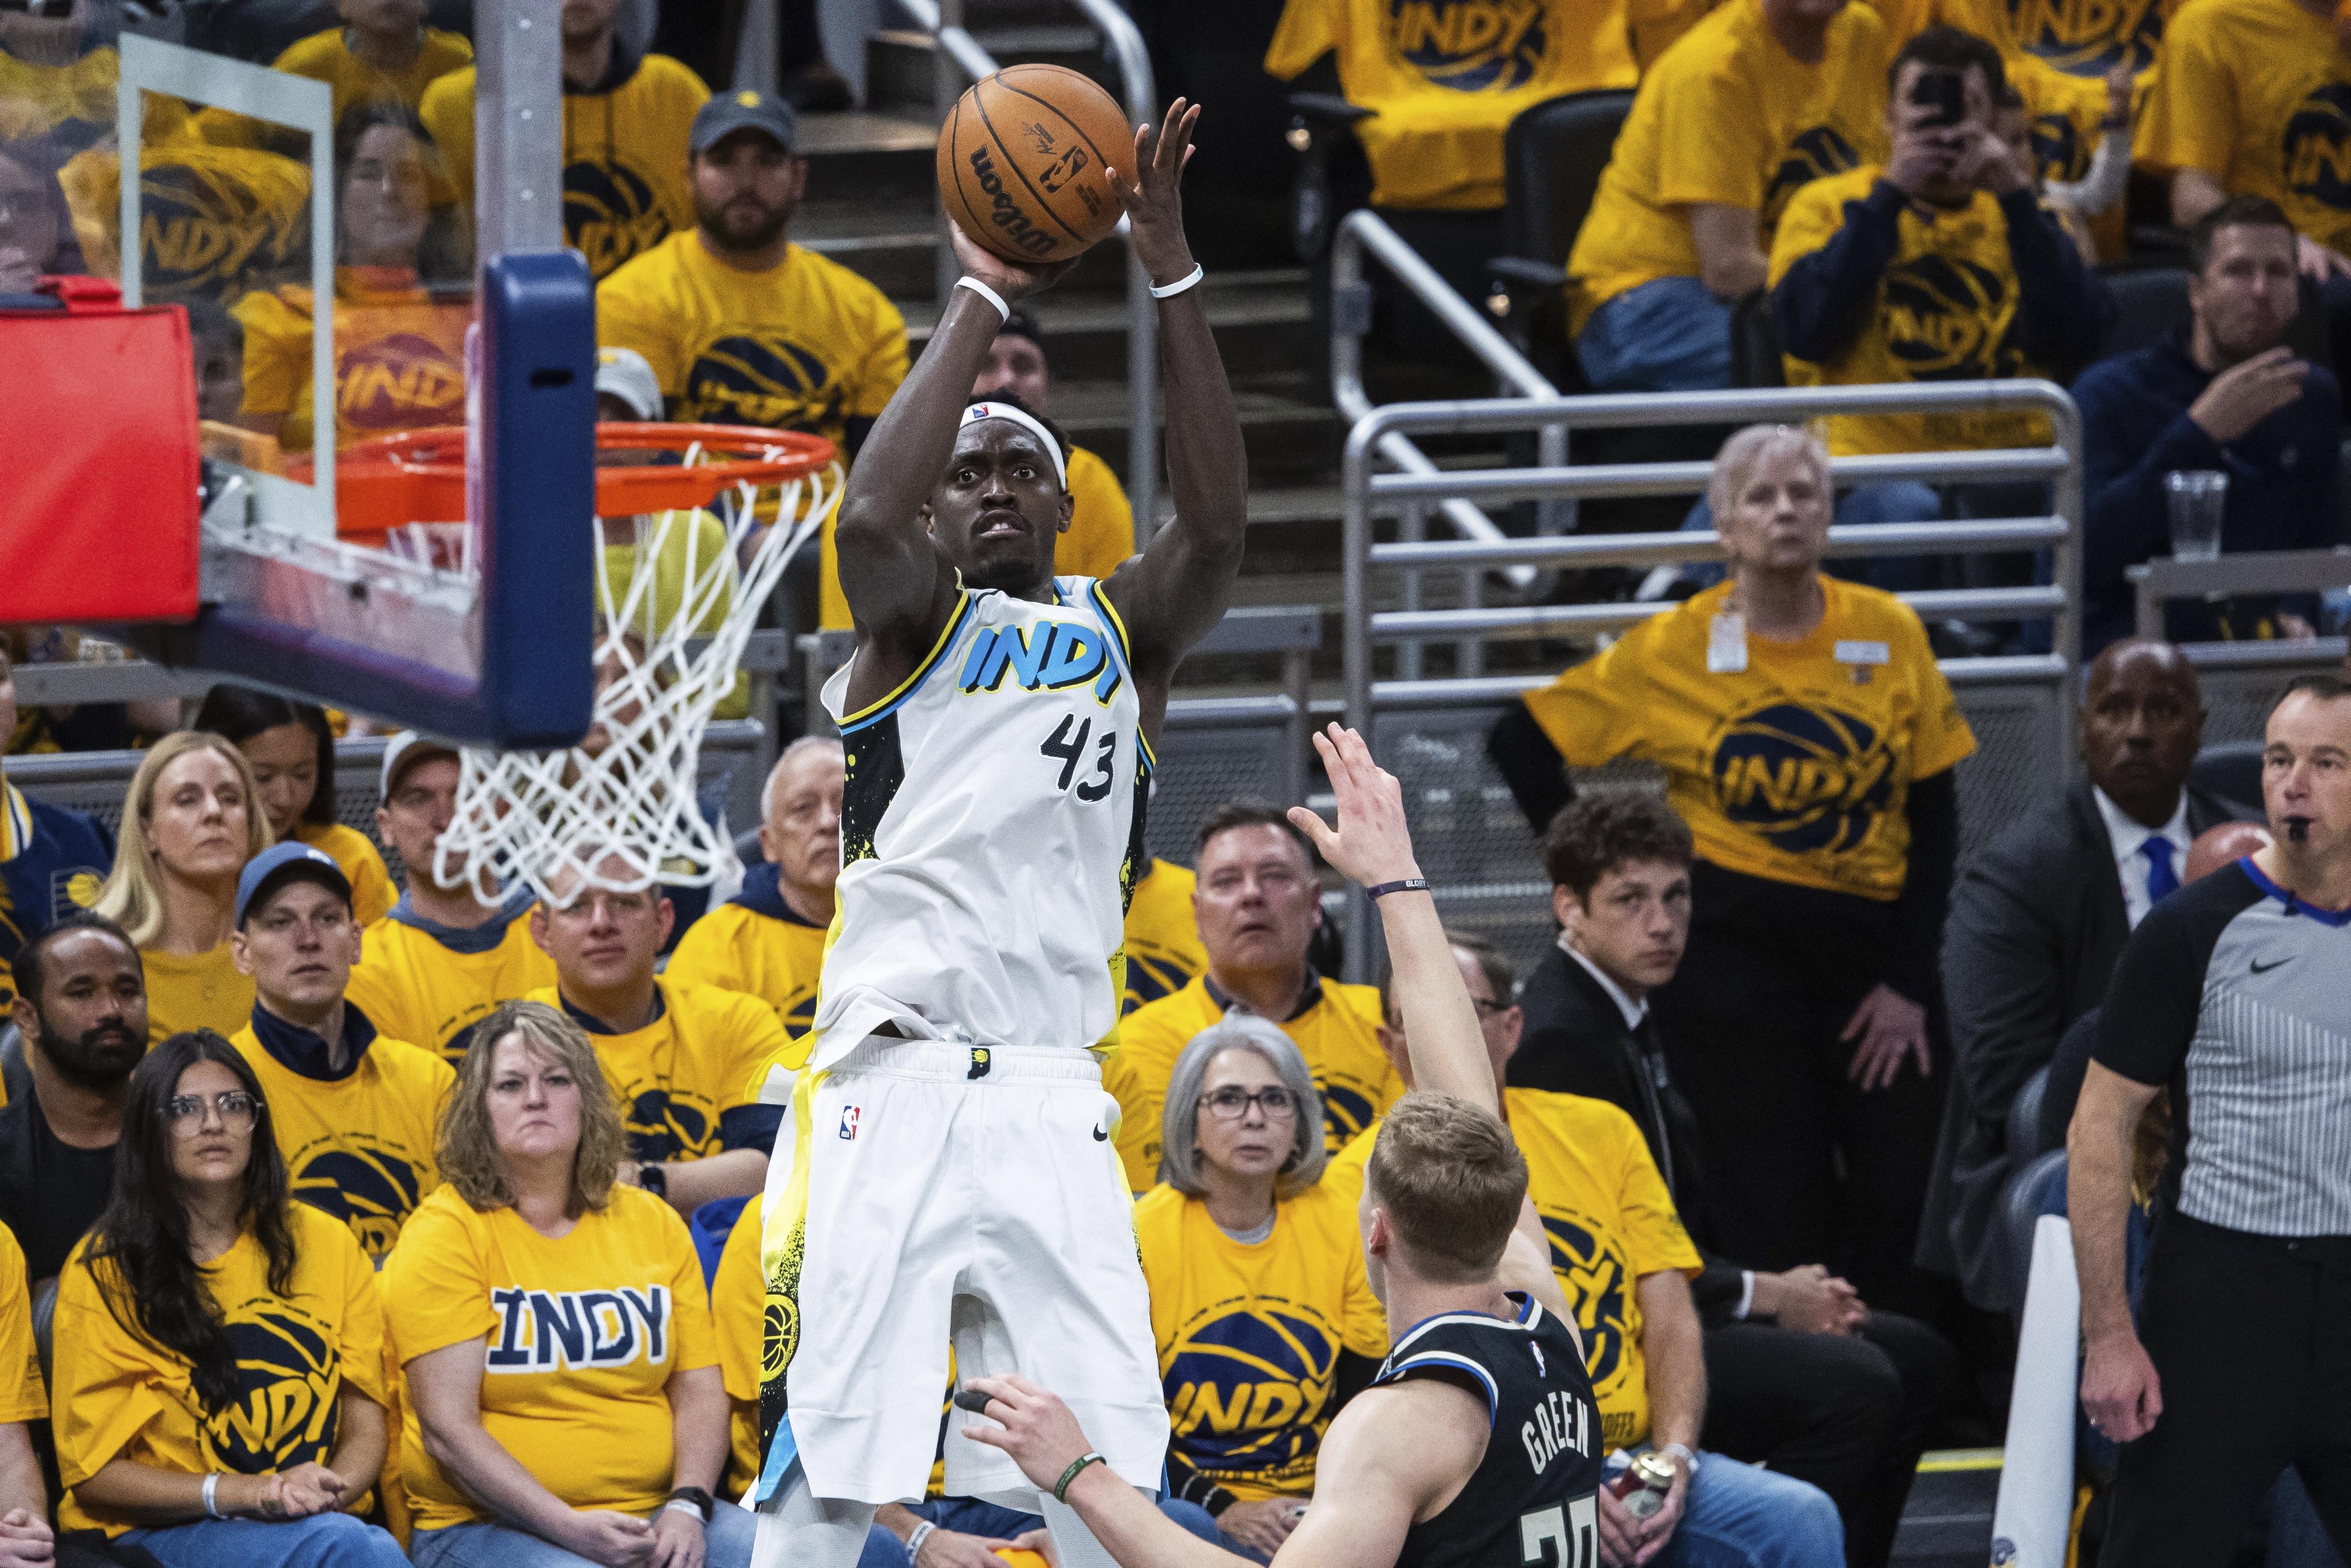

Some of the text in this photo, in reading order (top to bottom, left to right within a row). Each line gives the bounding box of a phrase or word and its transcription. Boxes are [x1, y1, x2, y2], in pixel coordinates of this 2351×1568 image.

[970, 144, 1059, 257] Wilson
[140, 211, 268, 276] NDY
[340, 363, 465, 410] IND
[957, 618, 1122, 708] INDY
[1038, 711, 1117, 804] 43
[1722, 753, 1888, 811] INDY
[1405, 879, 1426, 887] GLORY
[485, 1283, 673, 1374] INDY
[1170, 1377, 1333, 1438] INDY
[1522, 1390, 1589, 1475] GREEN
